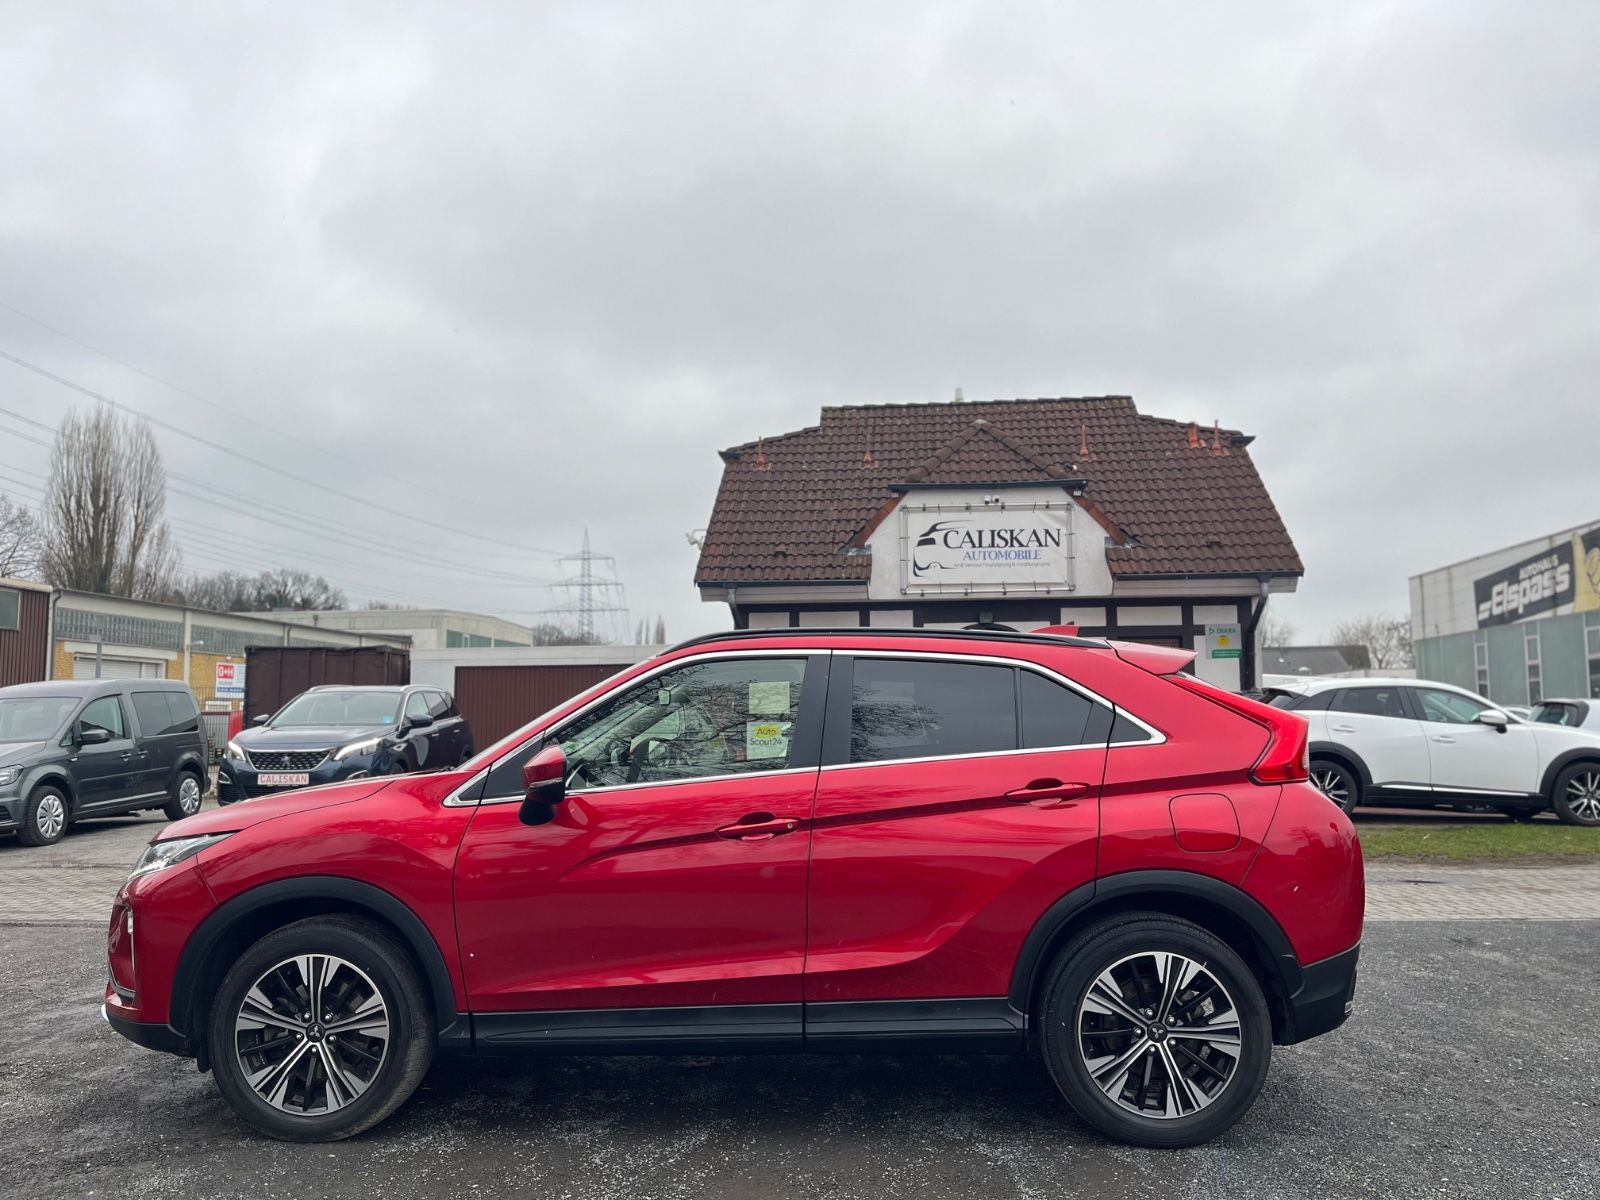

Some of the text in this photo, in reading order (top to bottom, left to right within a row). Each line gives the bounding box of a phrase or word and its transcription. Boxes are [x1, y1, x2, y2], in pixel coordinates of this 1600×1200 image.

[943, 528, 1061, 549] CALISKAN
[963, 550, 1042, 561] AUTOMOBILE
[756, 728, 777, 736] Auto
[750, 738, 782, 746] Scout24
[260, 775, 308, 784] CALISKAN
